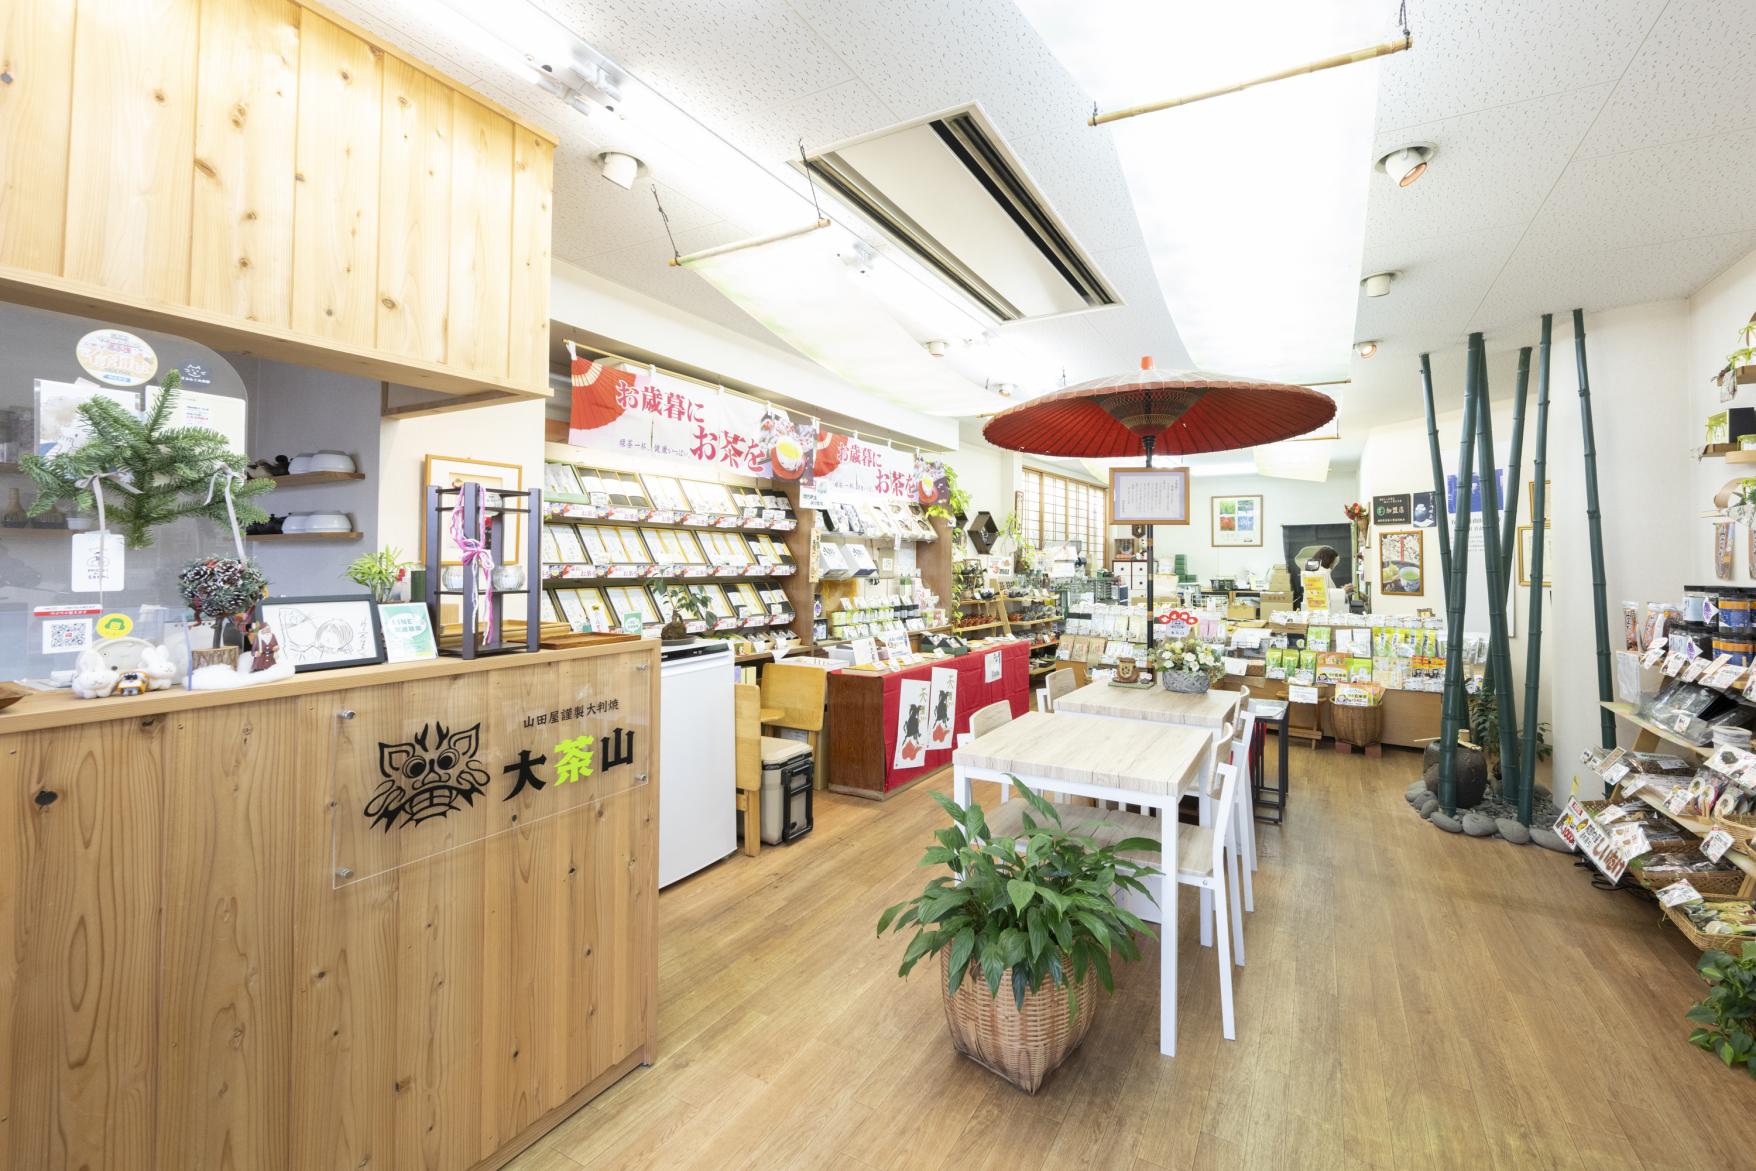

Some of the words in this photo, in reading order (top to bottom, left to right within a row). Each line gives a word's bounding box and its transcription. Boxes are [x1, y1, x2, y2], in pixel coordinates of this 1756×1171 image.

[615, 379, 705, 424] お歳暮に
[689, 424, 767, 473] お茶を
[836, 442, 883, 468] お歳暮に
[874, 468, 917, 500] お茶を
[522, 698, 620, 729] 山田屋謹製大判焼
[502, 726, 635, 802] 大茶山
